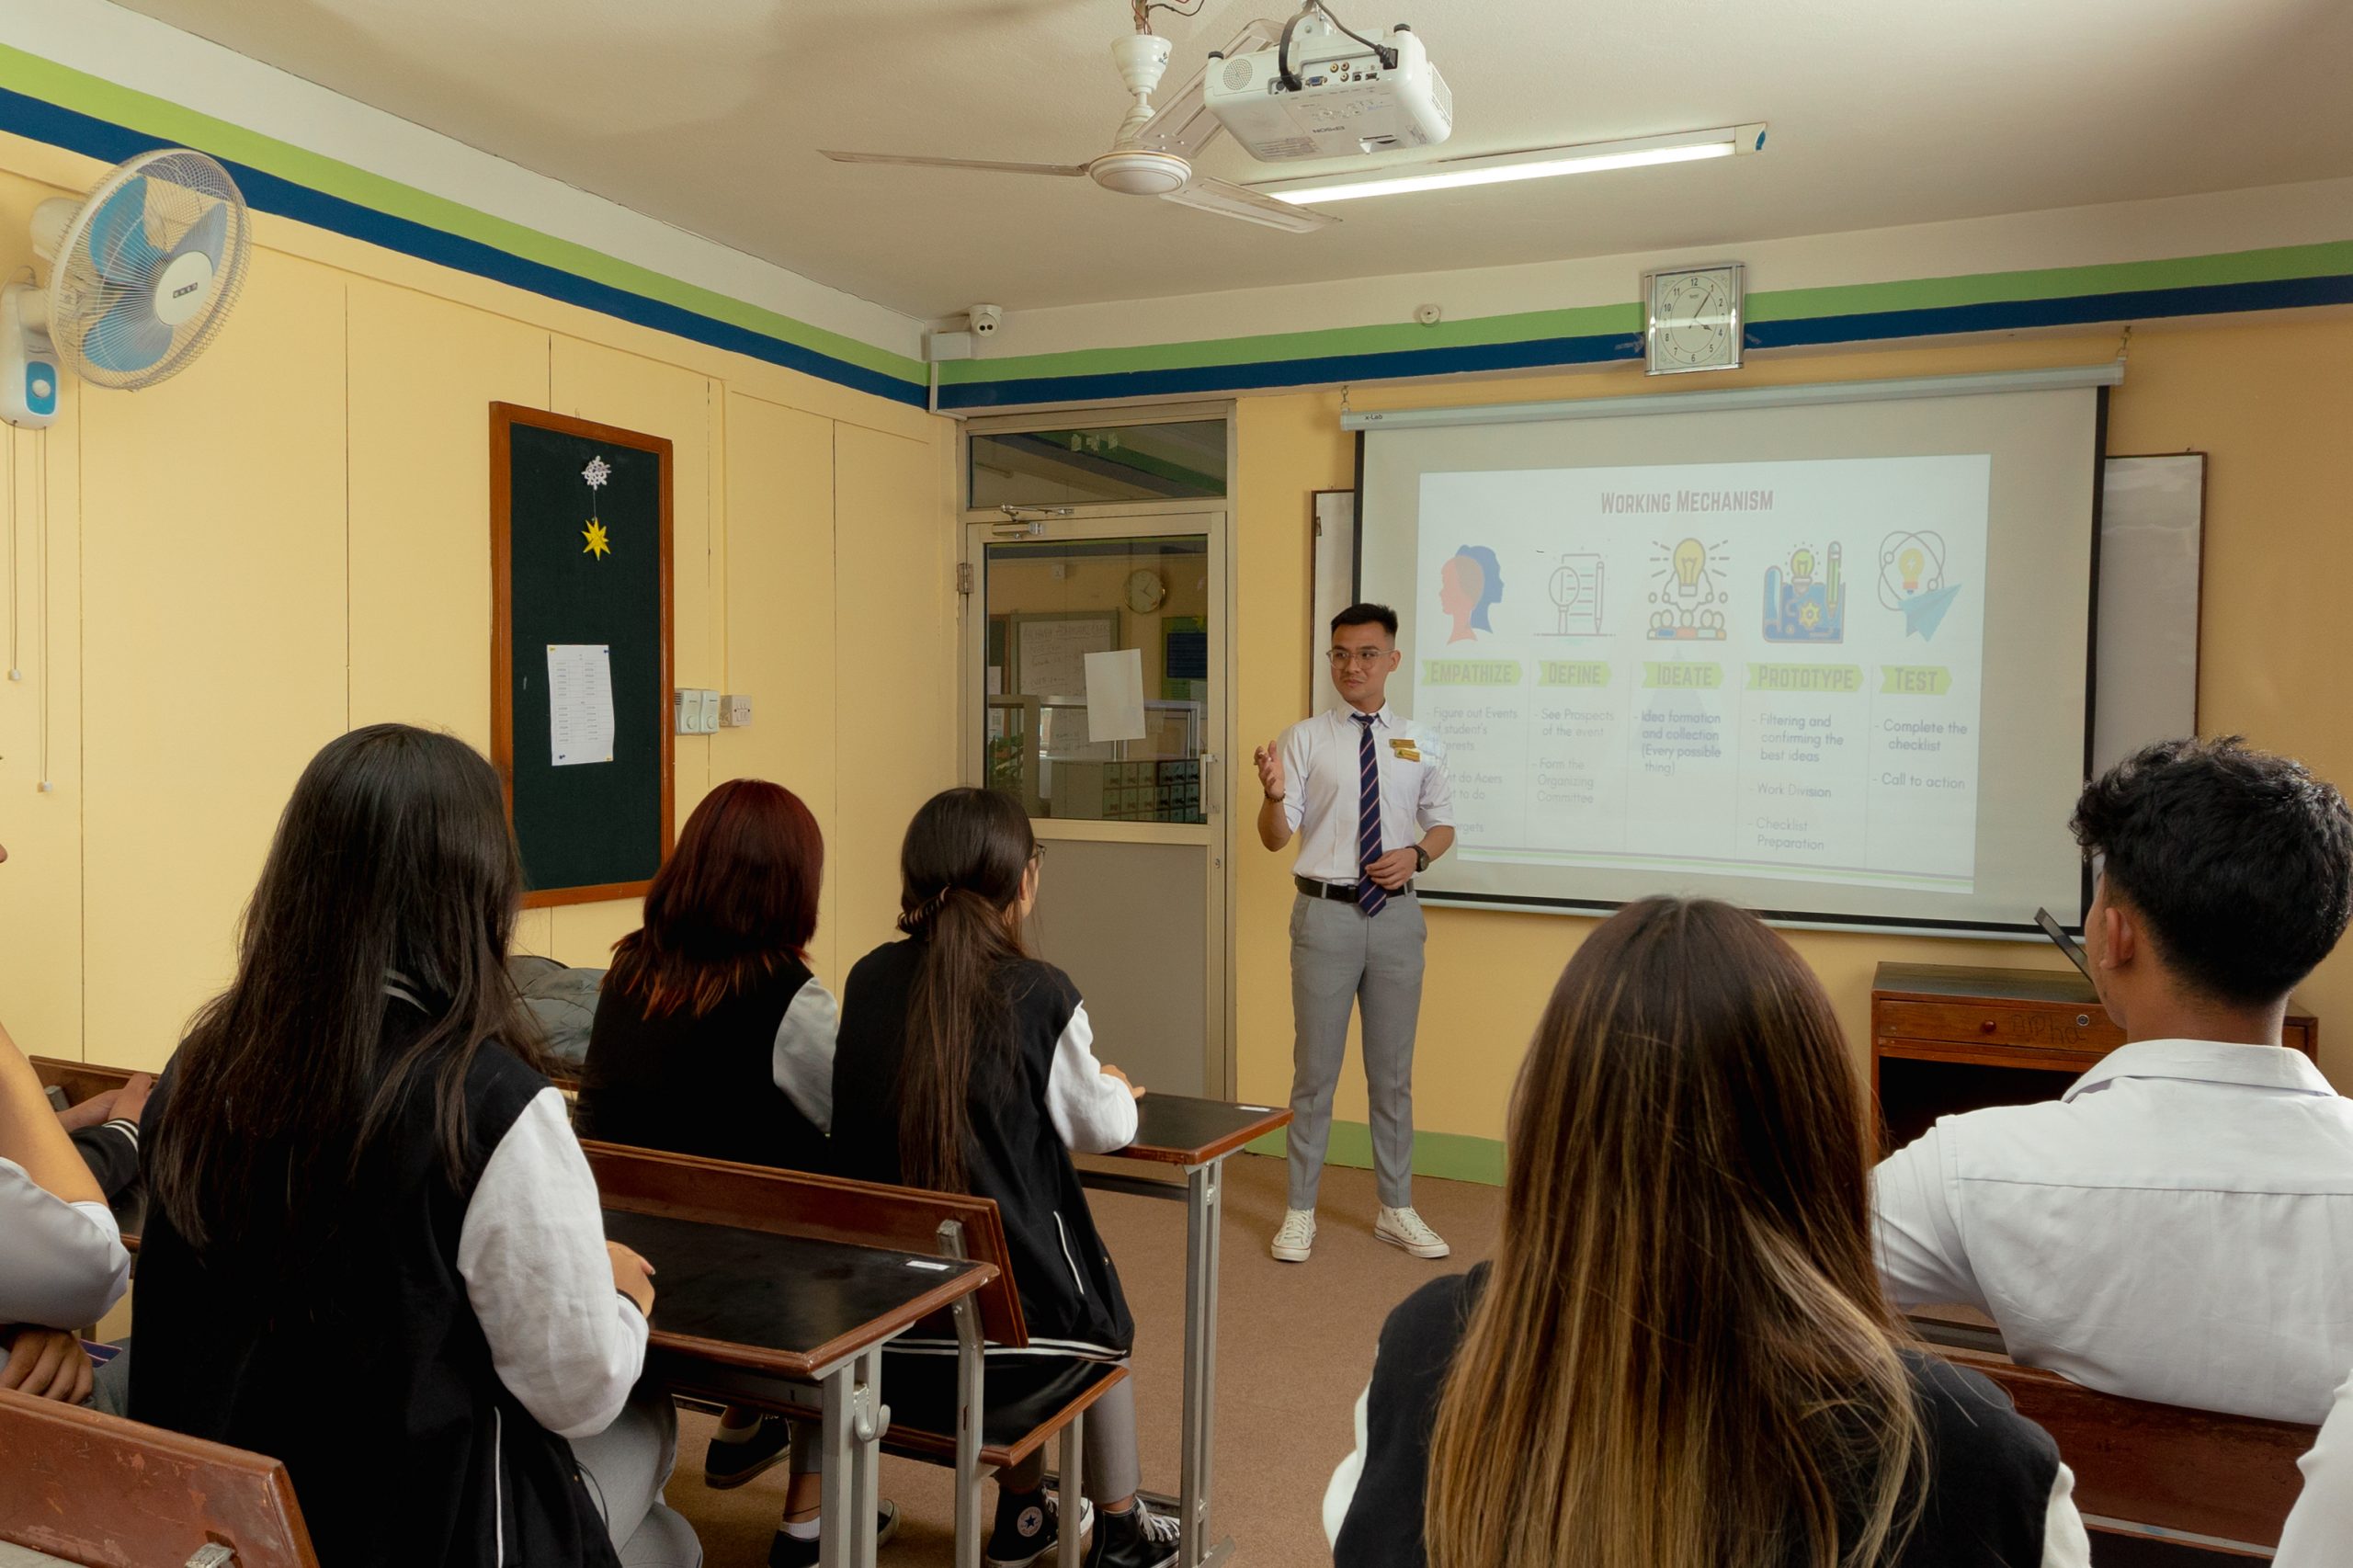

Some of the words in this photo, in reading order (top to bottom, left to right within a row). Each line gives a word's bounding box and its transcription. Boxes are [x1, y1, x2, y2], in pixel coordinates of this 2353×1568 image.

[1691, 278, 1699, 287] 12
[1711, 284, 1714, 292] 1
[1674, 288, 1680, 296] 11
[1664, 303, 1672, 312] 10
[1719, 298, 1723, 307] 2
[1665, 333, 1669, 342] 8
[1718, 328, 1723, 337] 4
[1674, 347, 1678, 357] 7
[1710, 344, 1714, 353] 5
[1691, 353, 1696, 362] 6
[1601, 492, 1671, 515] WORKING
[1677, 490, 1774, 513] MECHANISM
[1430, 662, 1512, 684] EMPATHIZE
[1548, 663, 1601, 685] DEFINE
[1657, 664, 1712, 687] IDEATE
[1757, 665, 1854, 689] PROTOTYPE
[1894, 667, 1938, 692] TEST
[1434, 707, 1464, 722] Figure
[1467, 708, 1483, 719] out
[1485, 707, 1518, 720] Events
[1541, 708, 1561, 721] See
[1564, 708, 1615, 723] Prospects
[1642, 710, 1665, 723] Idea
[1668, 710, 1721, 724] formation
[1759, 712, 1806, 731] Filtering
[1809, 714, 1831, 728] and
[1444, 722, 1487, 736] student's
[1542, 725, 1553, 737] of
[1556, 725, 1573, 737] the
[1575, 726, 1604, 737] event
[1642, 726, 1663, 740] and
[1666, 726, 1719, 742] collection
[1883, 718, 1945, 736] Complete
[1948, 720, 1968, 735] the
[1760, 730, 1822, 748] confirming
[1824, 733, 1844, 745] the
[1889, 737, 1941, 752] checklist
[1642, 742, 1674, 760] (Every
[1677, 743, 1722, 758] possible
[1760, 747, 1784, 762] best
[1788, 748, 1820, 763] ideas
[1540, 756, 1564, 770] Form
[1568, 757, 1585, 770] the
[1644, 760, 1675, 778] thing)
[1459, 771, 1472, 784] do
[1537, 773, 1594, 790] Organizing
[1881, 772, 1906, 787] Call
[1909, 774, 1922, 788] to
[1926, 775, 1966, 790] action
[1460, 789, 1470, 800] to
[1472, 788, 1485, 801] do
[1537, 789, 1594, 804] Committee
[1757, 782, 1784, 796] Work
[1788, 783, 1831, 798] Division
[1756, 816, 1808, 832] Checklist
[1757, 834, 1824, 851] Preparation
